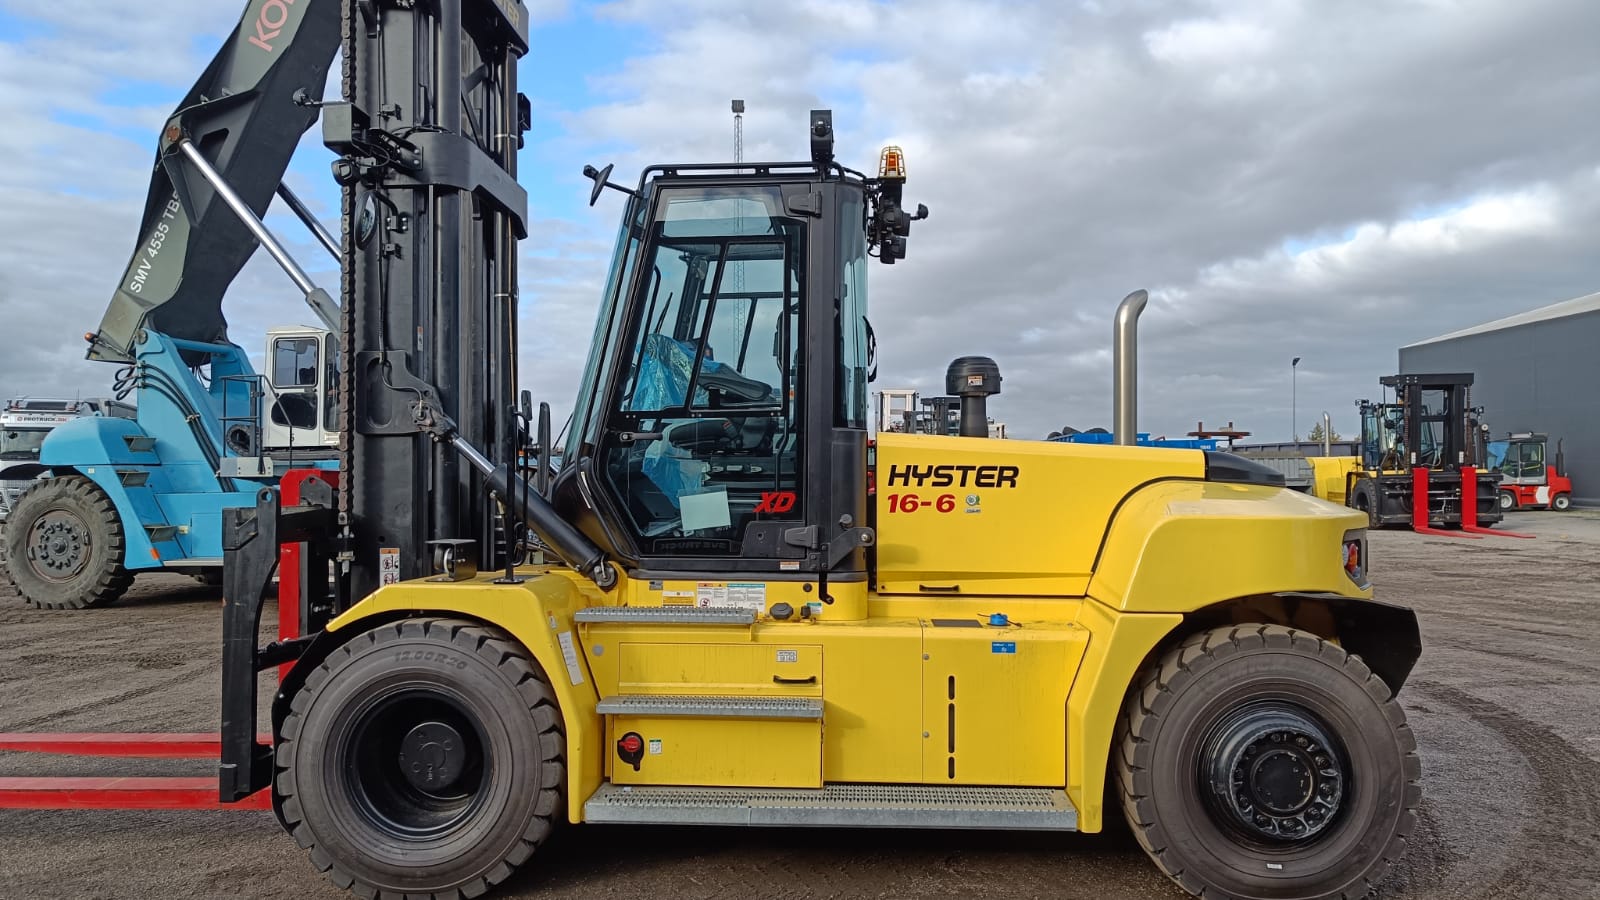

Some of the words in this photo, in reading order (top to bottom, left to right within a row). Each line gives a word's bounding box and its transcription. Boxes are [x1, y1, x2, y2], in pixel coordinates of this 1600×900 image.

[248, 0, 294, 52] KO
[130, 258, 152, 293] SMV
[147, 222, 170, 258] 4535
[887, 464, 1020, 488] HYSTER
[752, 492, 796, 513] XD
[887, 494, 956, 513] 16-6
